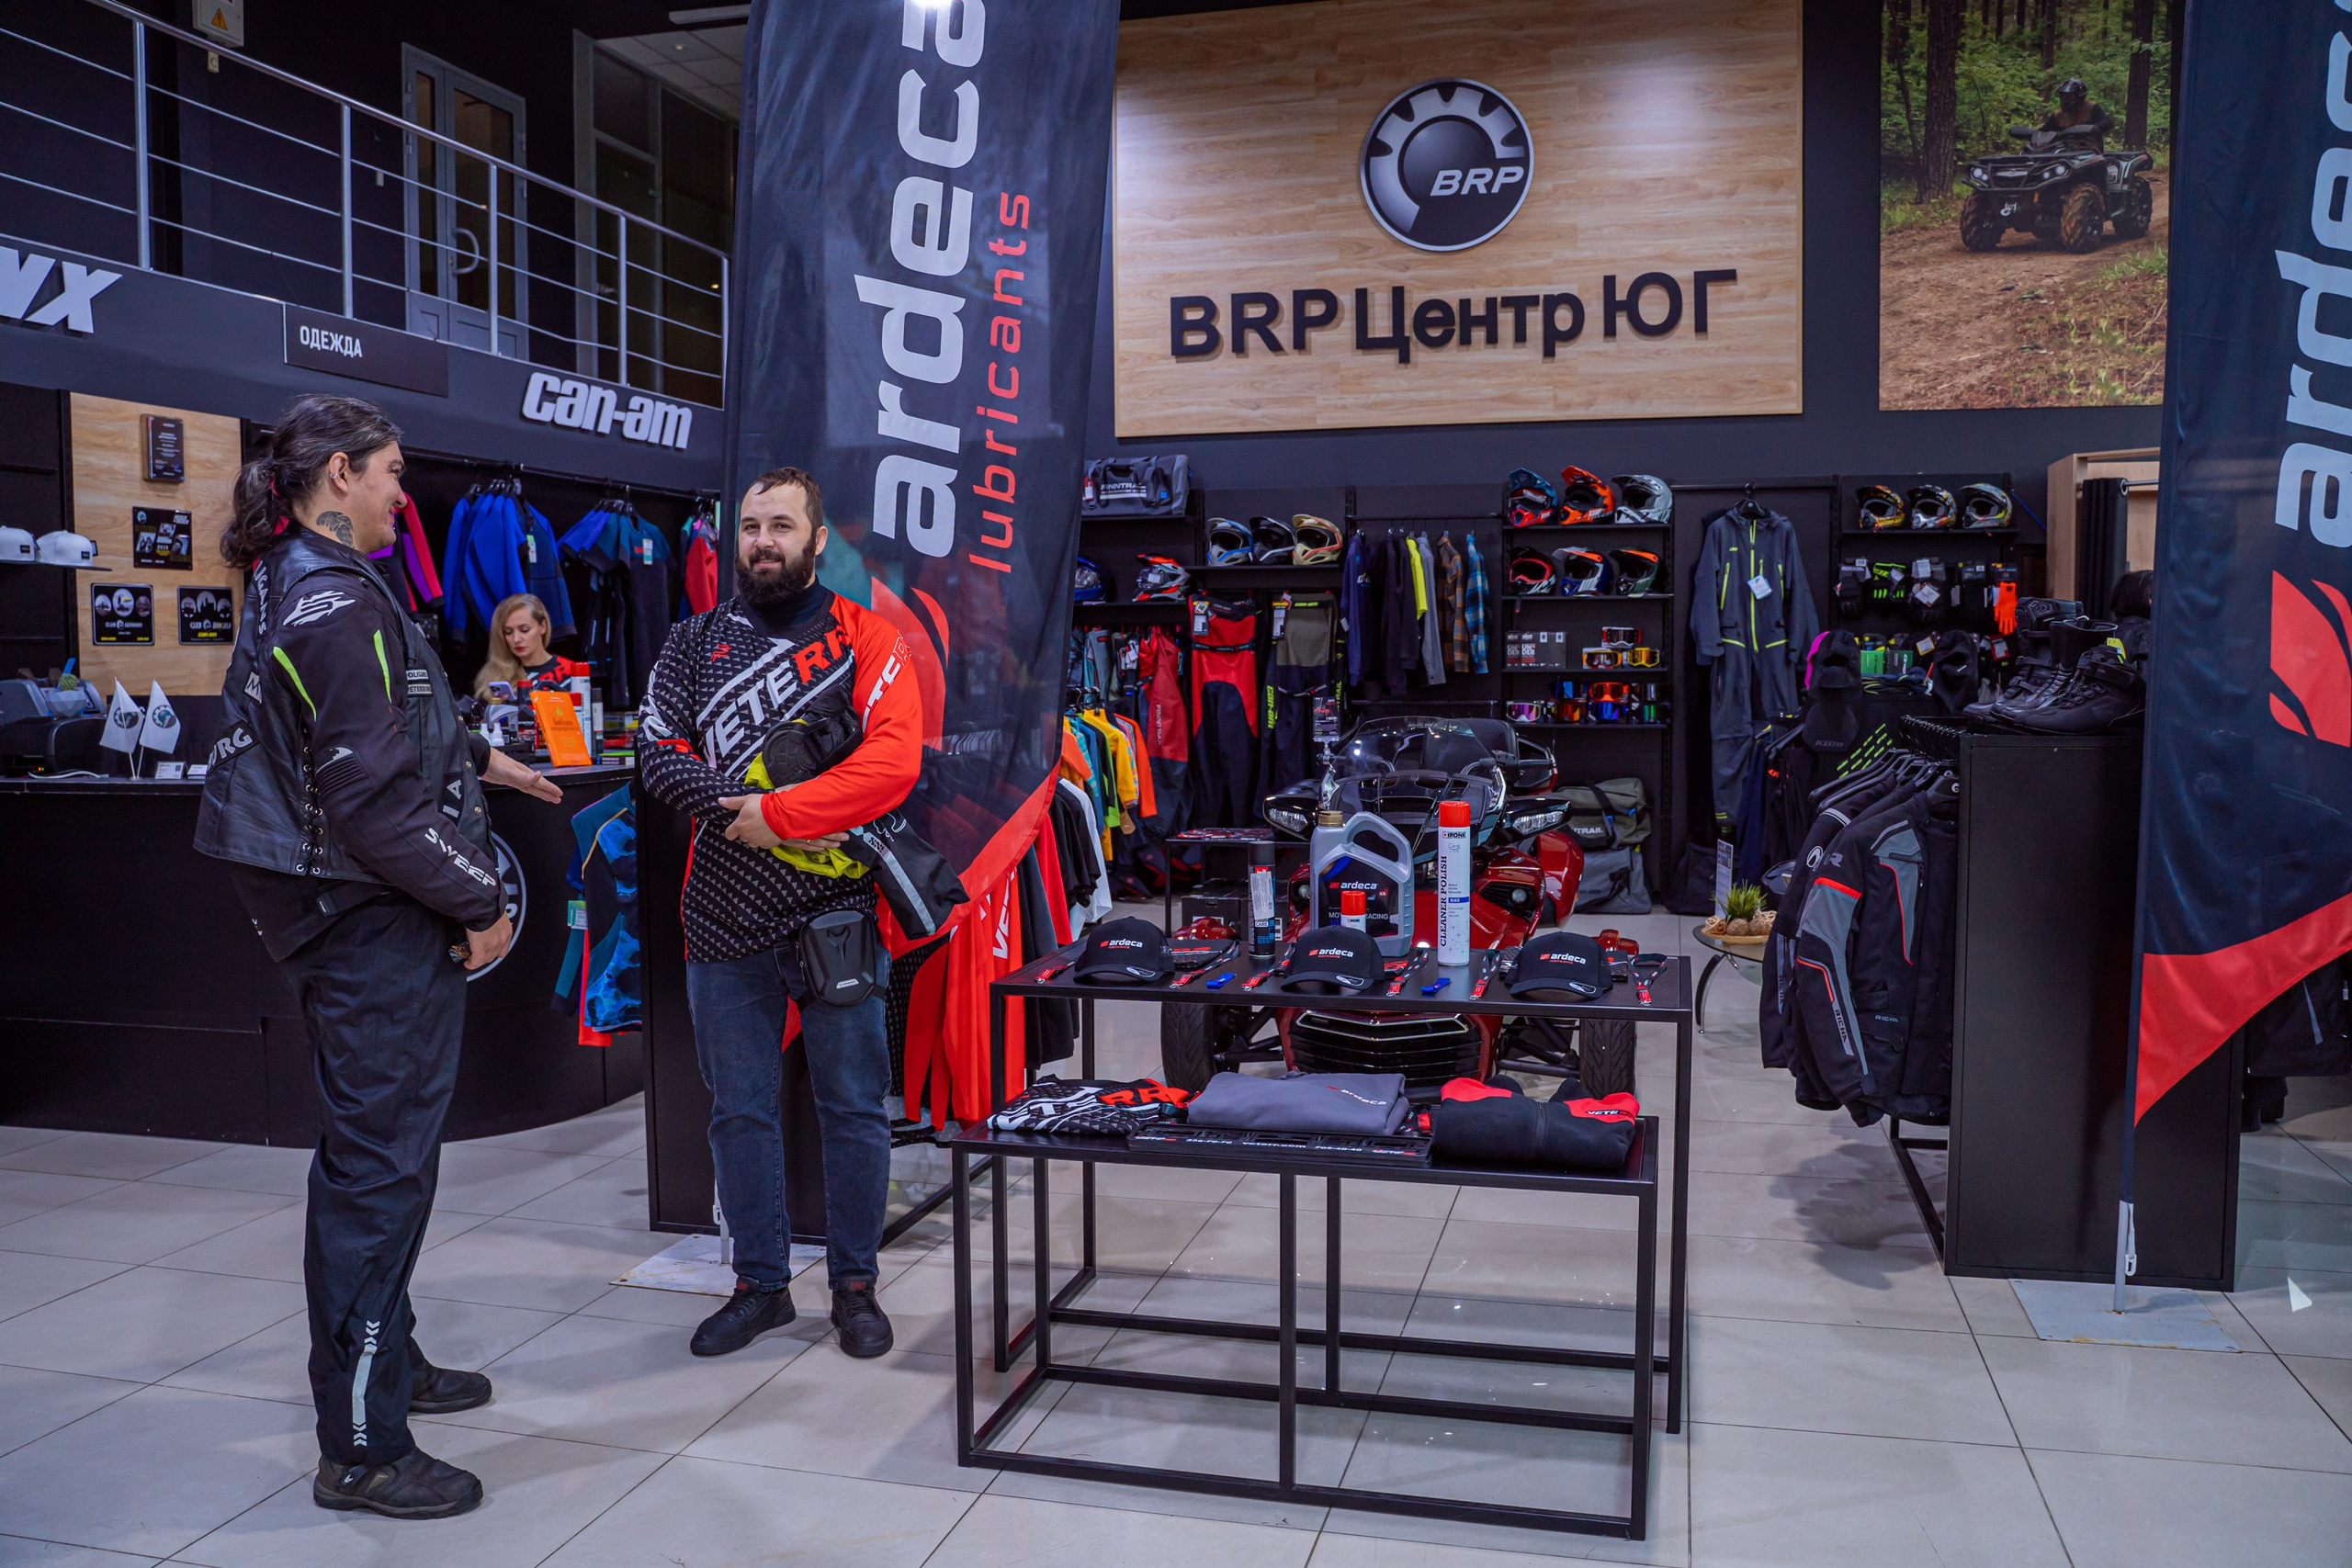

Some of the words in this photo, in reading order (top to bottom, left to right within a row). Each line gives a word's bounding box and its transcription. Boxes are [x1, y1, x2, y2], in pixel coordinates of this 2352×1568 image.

[1430, 166, 1524, 197] BRP
[1170, 288, 1339, 356] BRP
[1355, 286, 1585, 364] Центр
[1603, 268, 1737, 338] ЮГ
[300, 325, 363, 358] ОДЕЖДА
[969, 192, 1031, 572] lubricants
[522, 371, 692, 450] can-am
[1340, 881, 1377, 890] ardeca
[1109, 939, 1143, 947] ardeca
[1318, 948, 1353, 957] ardeca
[1551, 953, 1586, 964] ardeca
[1835, 1010, 1848, 1043] RICHA
